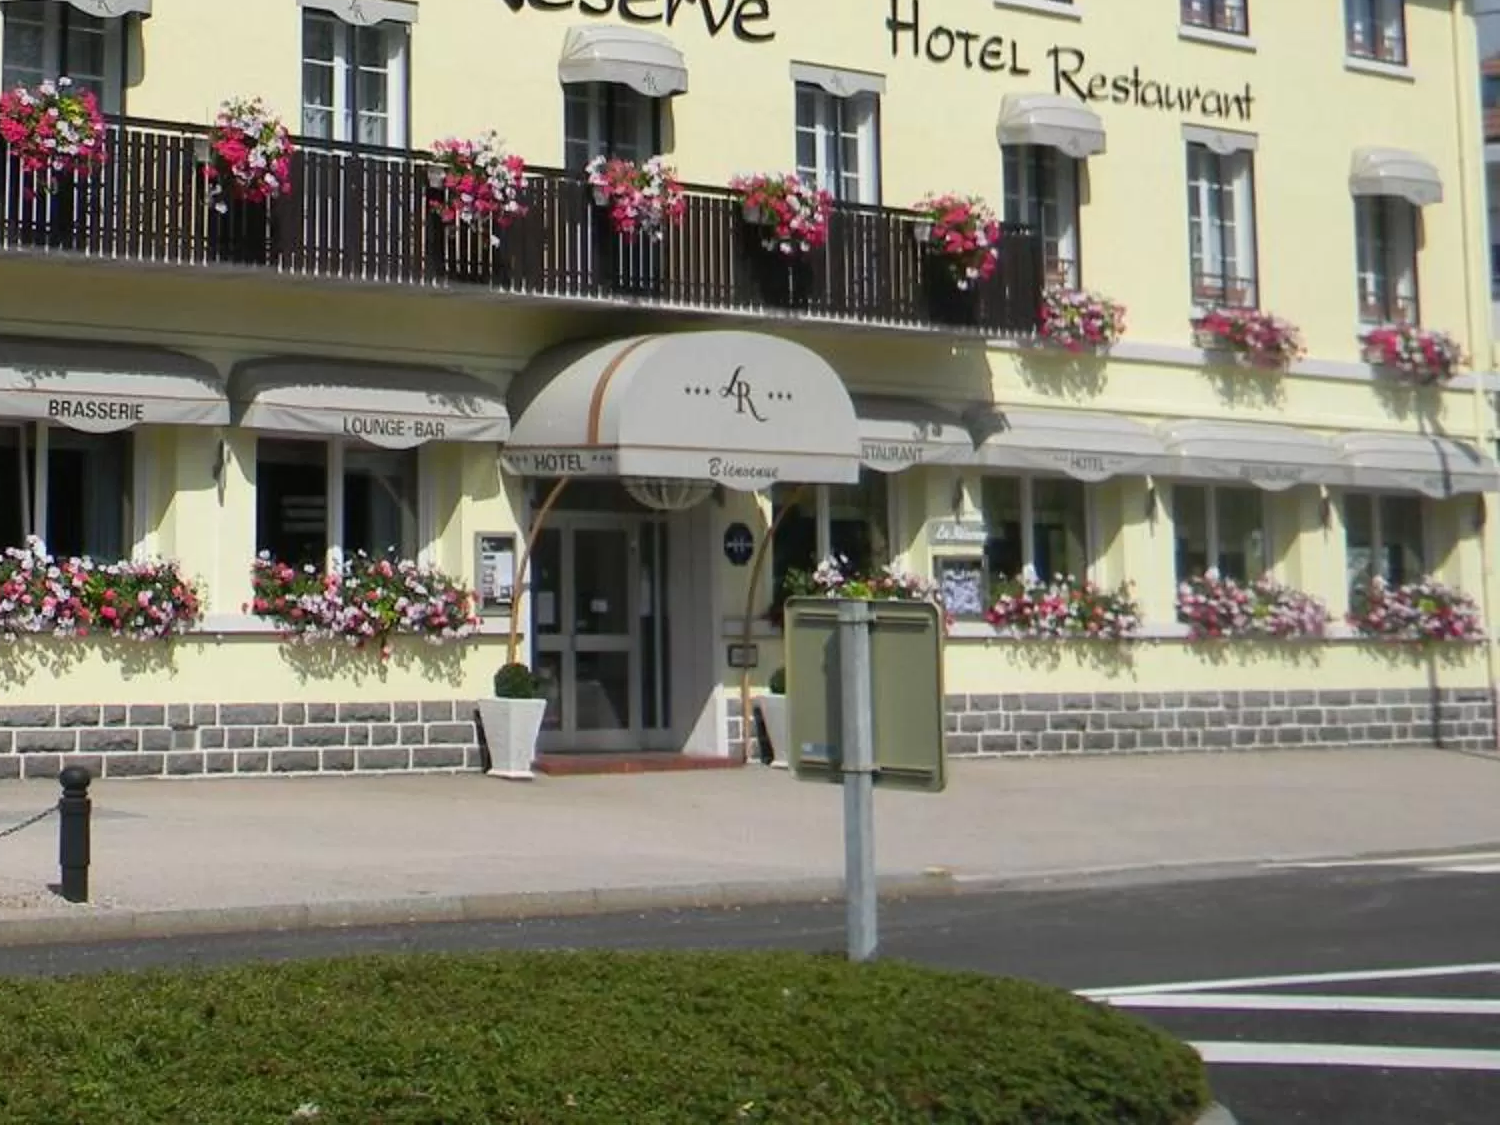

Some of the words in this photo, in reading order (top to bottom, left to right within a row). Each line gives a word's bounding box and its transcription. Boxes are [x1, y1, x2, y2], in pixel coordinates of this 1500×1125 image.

[1047, 45, 1256, 122] Restaurant
[48, 398, 145, 421] BRASSERIE
[342, 415, 446, 440] LOUNGE-BAR
[534, 454, 587, 472] HOTEL
[860, 442, 925, 463] STAURANT
